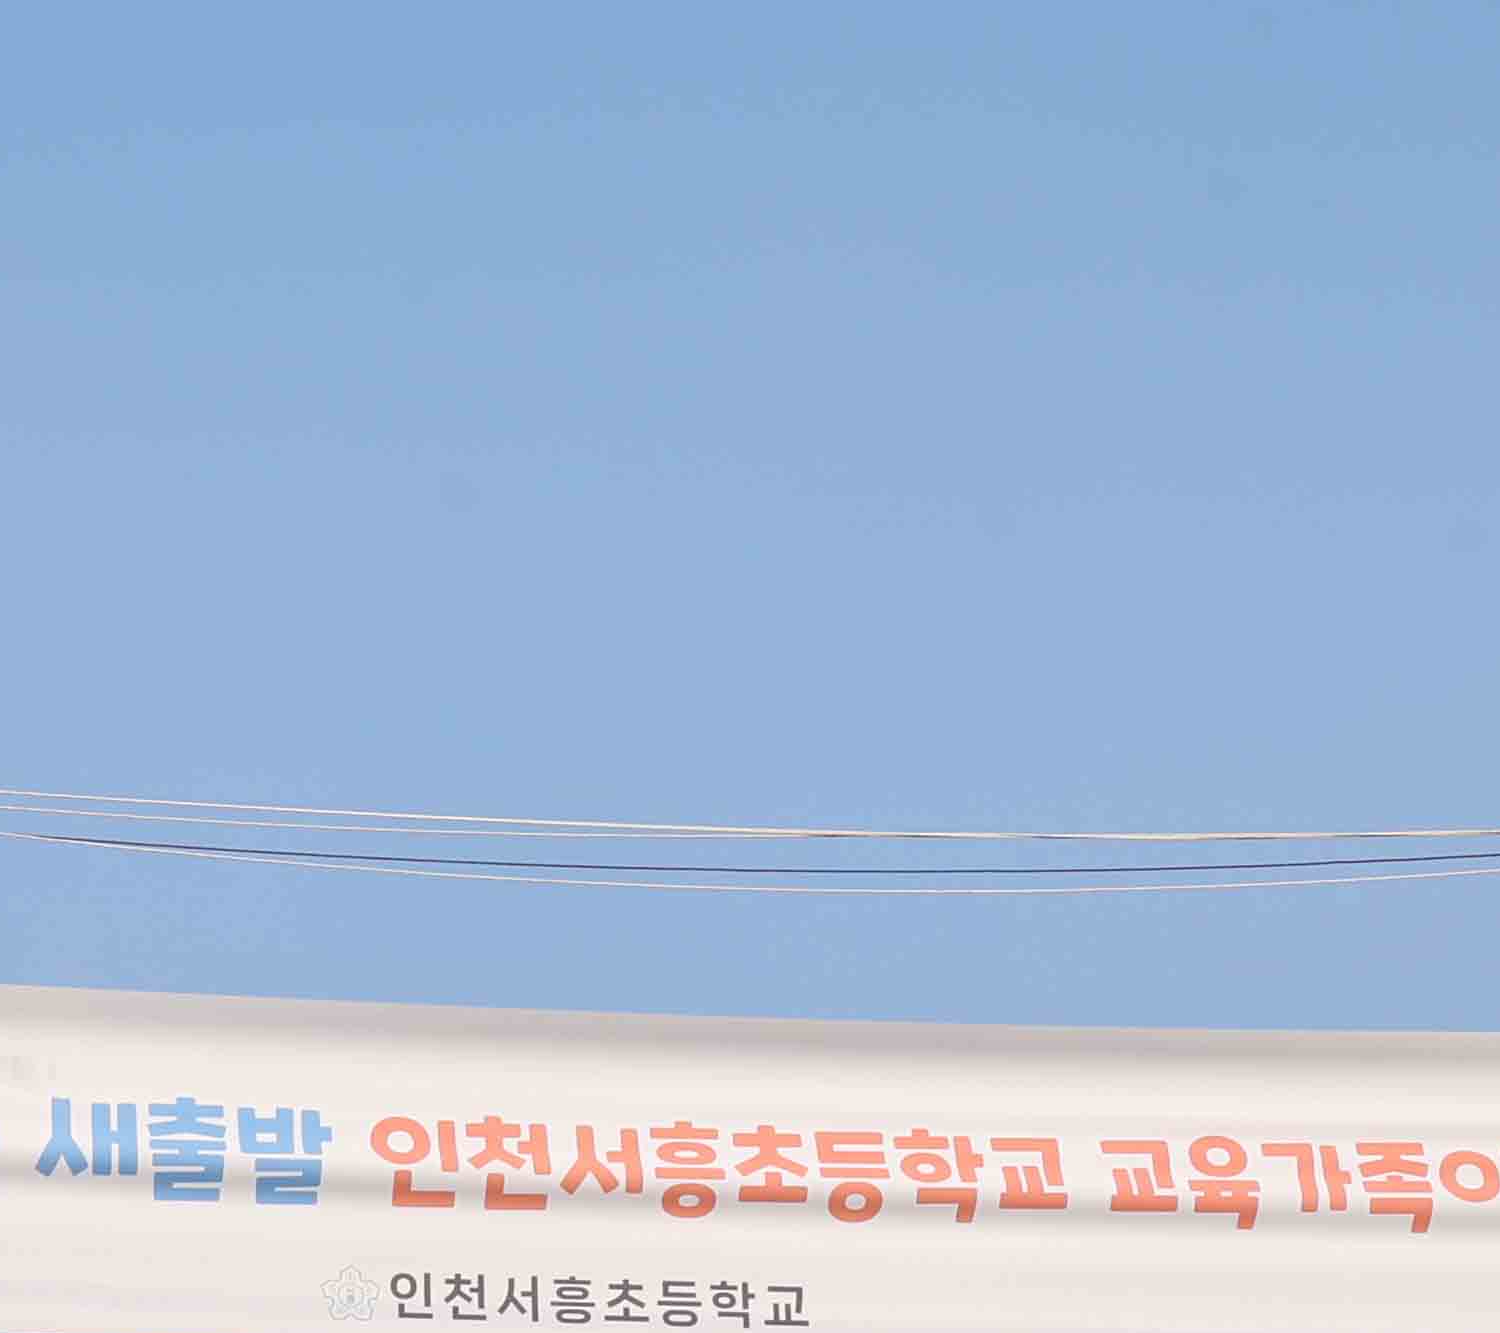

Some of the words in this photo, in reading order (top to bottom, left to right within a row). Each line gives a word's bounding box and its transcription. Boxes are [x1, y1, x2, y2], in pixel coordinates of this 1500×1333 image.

[33, 1095, 334, 1210] 새출발
[368, 1113, 1070, 1223] 인천서흥초등학교
[389, 1269, 813, 1328] 인천서흥초등학교
